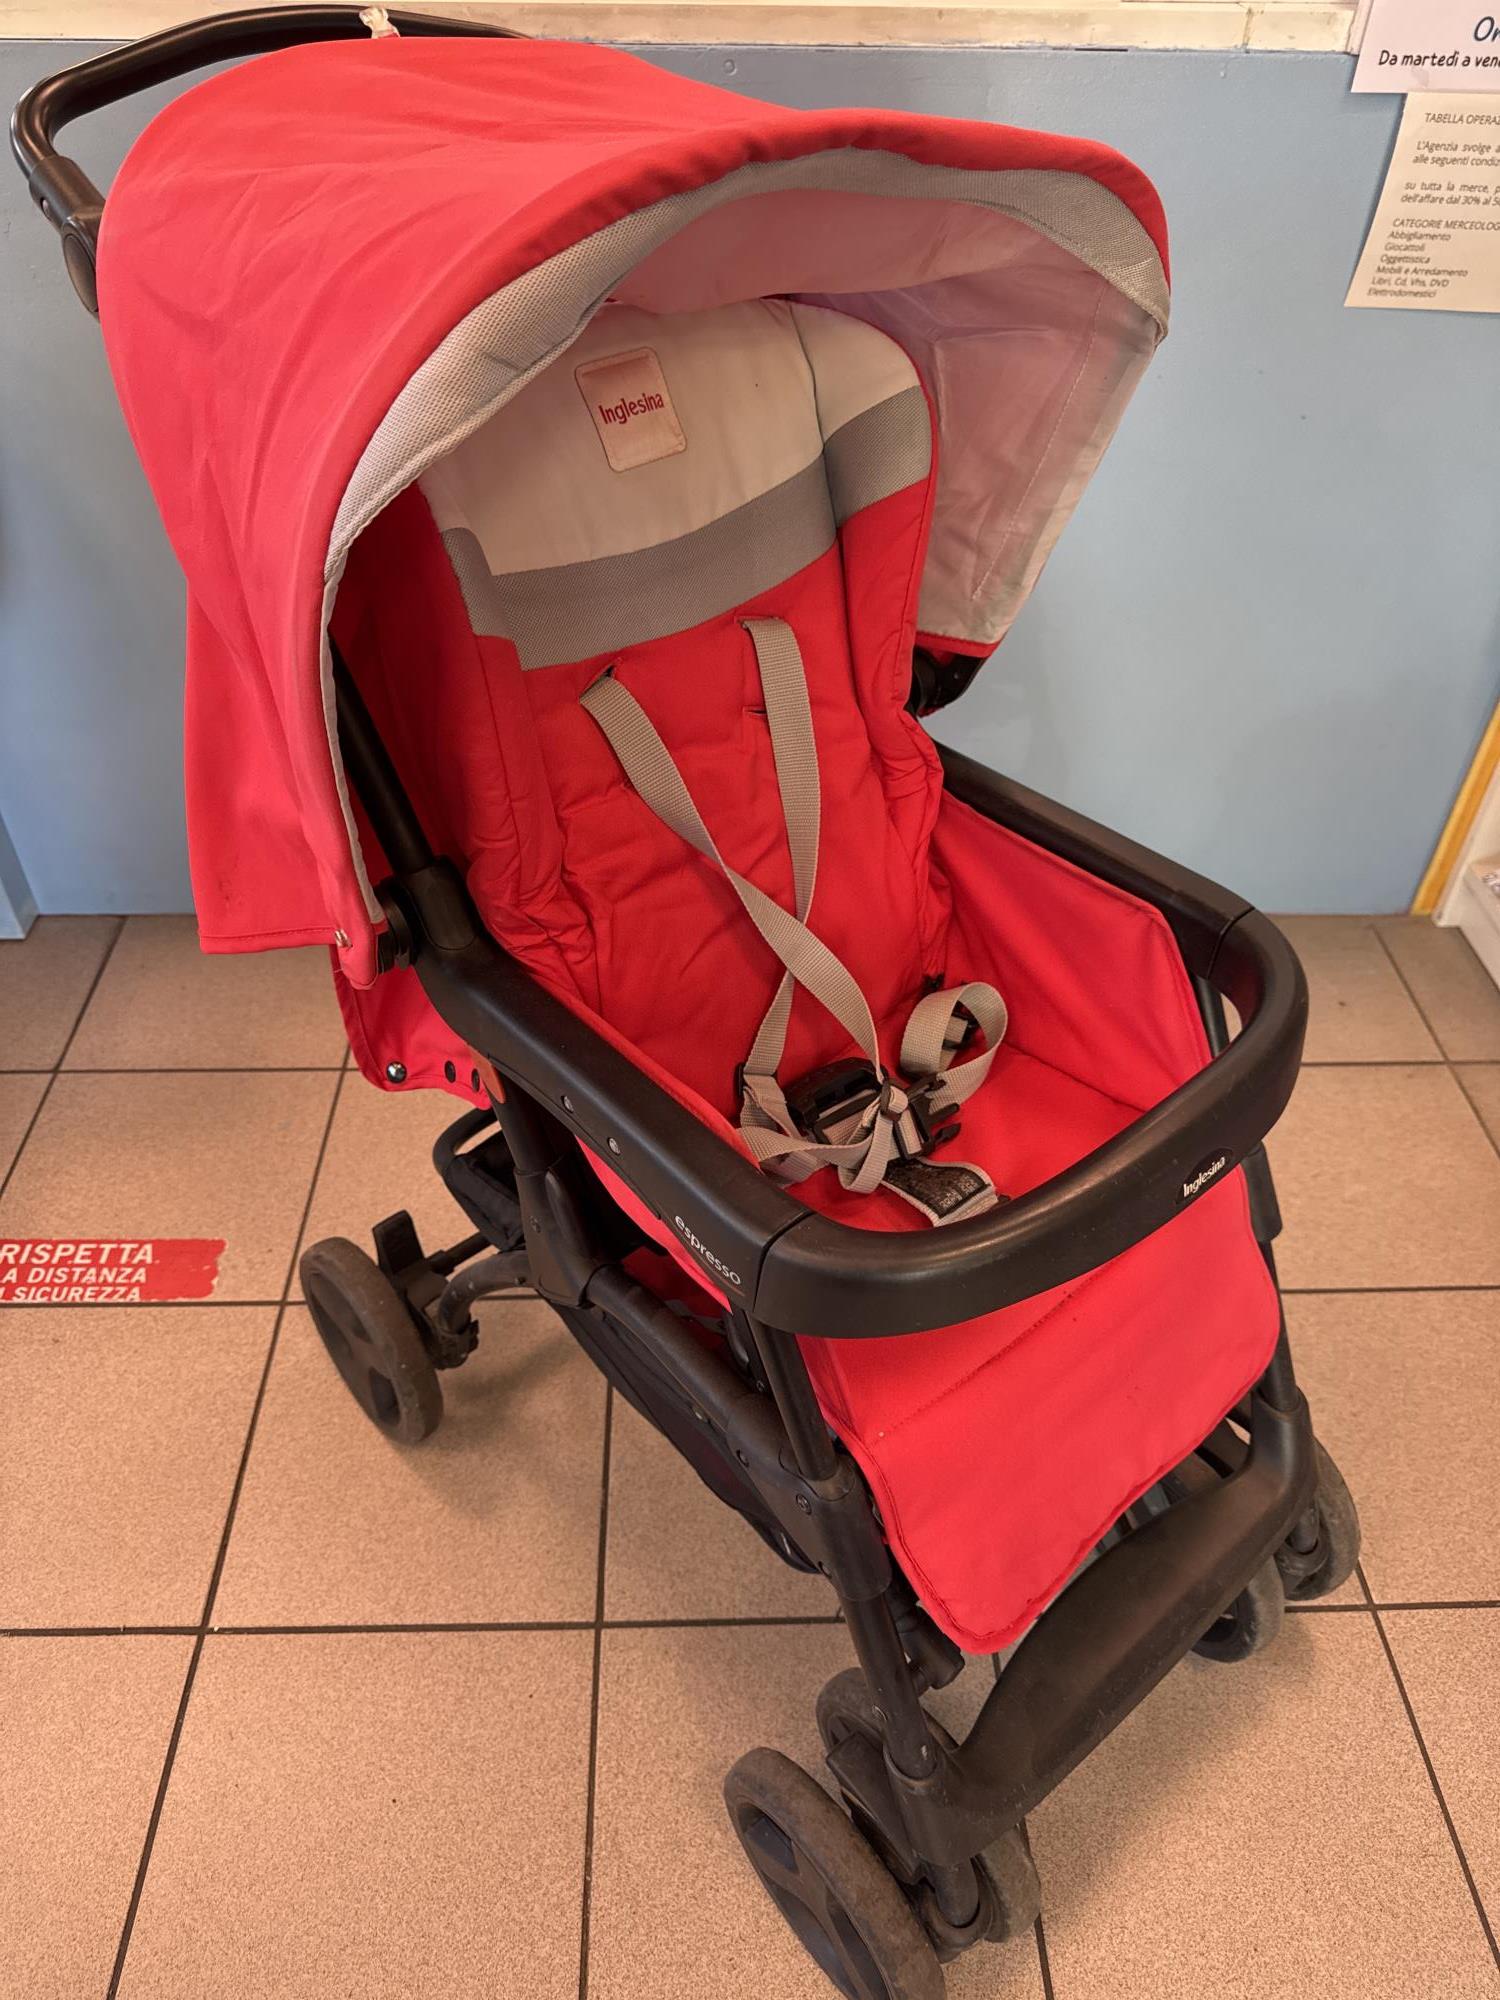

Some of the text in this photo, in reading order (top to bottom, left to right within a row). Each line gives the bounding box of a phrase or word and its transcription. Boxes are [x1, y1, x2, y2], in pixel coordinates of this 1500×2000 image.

[1378, 50, 1500, 67] Da martedì a ven
[1425, 113, 1464, 125] TABELLA
[1416, 141, 1459, 153] L'Agenzia
[1462, 142, 1492, 155] svolge
[1412, 154, 1429, 164] alle
[1430, 156, 1469, 167] seguenti
[1404, 182, 1417, 190] su
[1420, 181, 1442, 191] tutta
[1447, 181, 1455, 191] la
[1446, 195, 1460, 205] dal
[1482, 195, 1492, 205] al
[1392, 218, 1442, 230] CATEGORIE
[1388, 231, 1451, 242] Abbigliamento
[1384, 242, 1426, 252] Giocattoli
[1380, 254, 1430, 265] Oggettistica
[1411, 267, 1468, 277] Arredamento
[1429, 279, 1450, 288] DVD
[598, 393, 664, 424] Inglesina
[1183, 1156, 1226, 1198] Inglesina
[675, 1215, 741, 1285] espresso
[27, 1267, 147, 1284] DISTANZA
[12, 1286, 141, 1302] SICUREZZA
